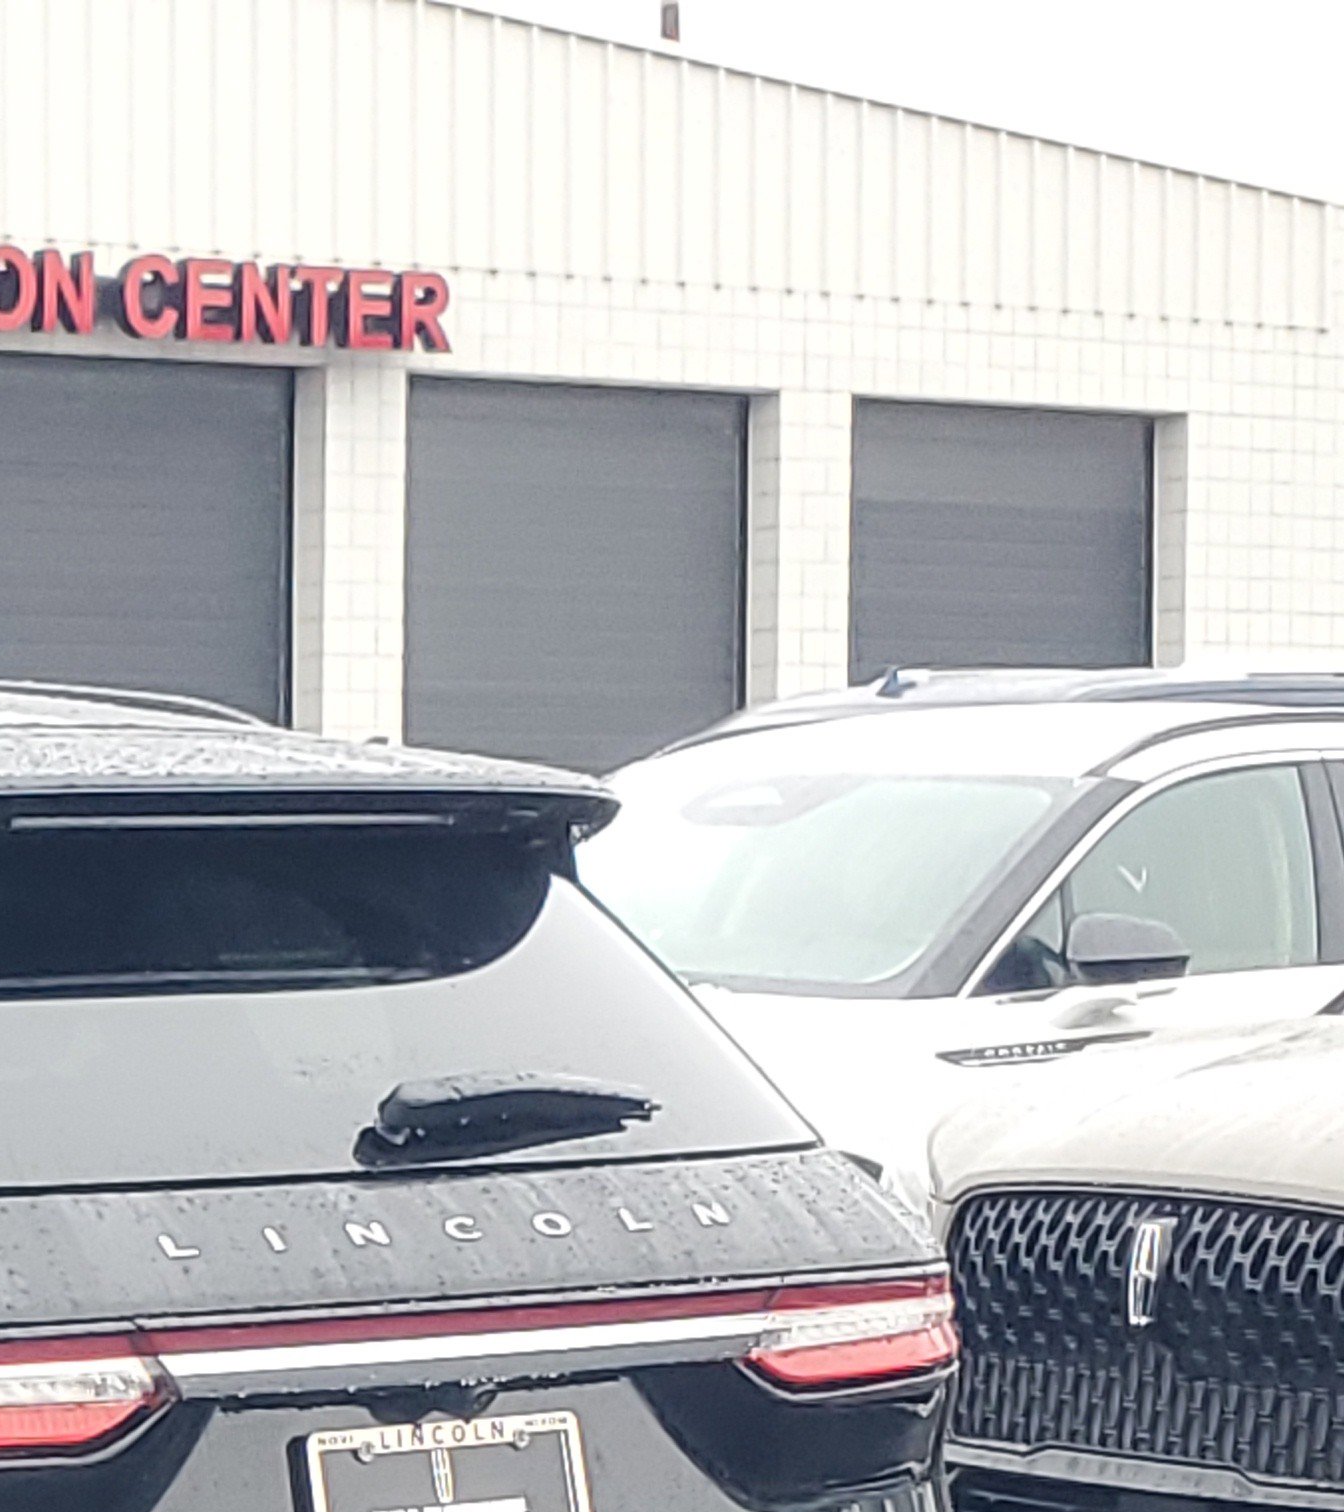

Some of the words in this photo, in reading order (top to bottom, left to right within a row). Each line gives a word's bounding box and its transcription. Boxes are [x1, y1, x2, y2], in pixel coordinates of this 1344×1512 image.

[120, 253, 452, 353] CENTER
[157, 1201, 731, 1261] LINCOLN
[379, 1420, 506, 1450] LINCOLN
